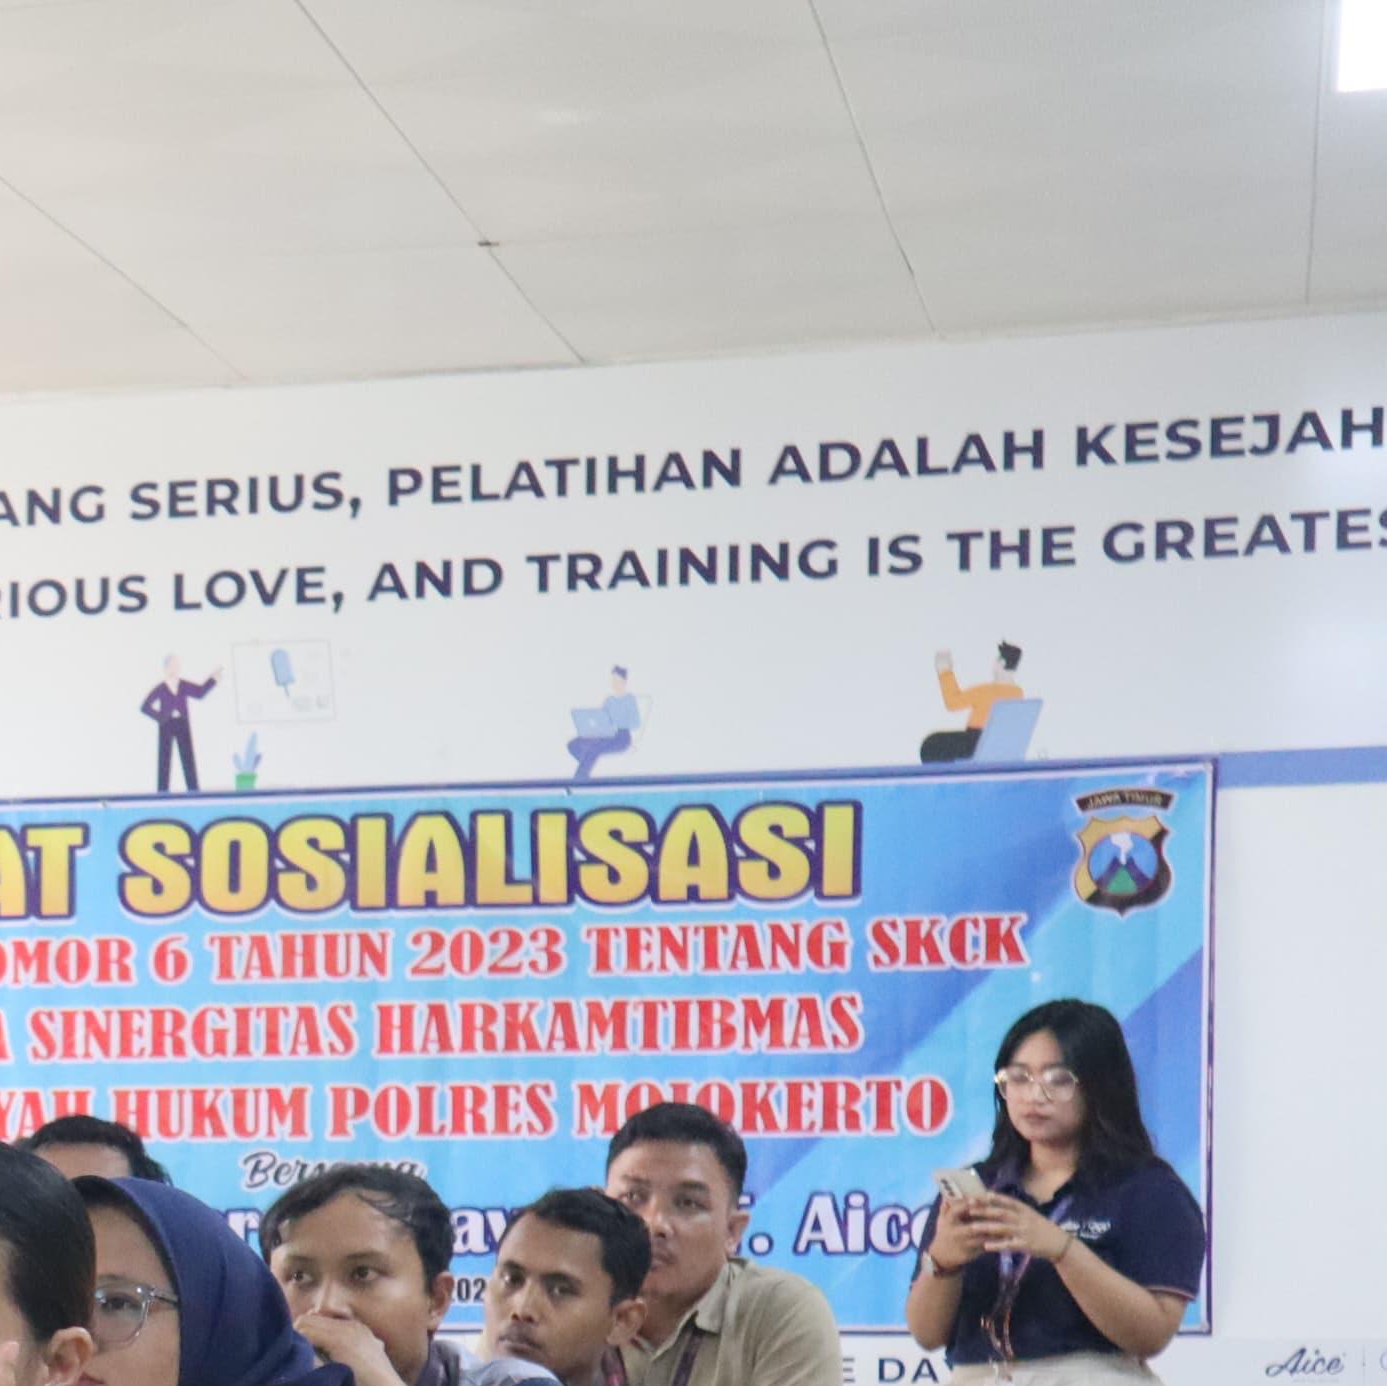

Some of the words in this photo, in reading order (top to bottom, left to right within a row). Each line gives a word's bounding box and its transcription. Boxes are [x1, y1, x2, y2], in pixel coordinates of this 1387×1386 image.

[129, 470, 362, 522] SERIUS,
[387, 447, 742, 508] PELATIHAN
[767, 428, 1045, 487] ADALAH
[1075, 405, 1385, 468] KESEJAH
[173, 565, 345, 615] LOVE,
[366, 557, 504, 603] AND
[524, 538, 839, 594] TRAINING
[867, 533, 924, 578] IS
[945, 524, 1077, 573] THE
[1101, 507, 1387, 565] GREATE
[119, 801, 862, 916] SOSIALISASI
[154, 936, 189, 981] 6
[211, 932, 390, 980] TAHUN
[411, 929, 565, 976] 2023
[588, 921, 849, 972] TENTANG
[870, 915, 1028, 966] SKCK
[29, 1004, 357, 1060] SINERGITAS
[374, 995, 863, 1056] HARKAMTIBMAS
[113, 1087, 309, 1139] HUKUM
[329, 1083, 555, 1137] POLRES
[878, 1357, 945, 1384] DA
[1265, 1346, 1344, 1378] Aice
